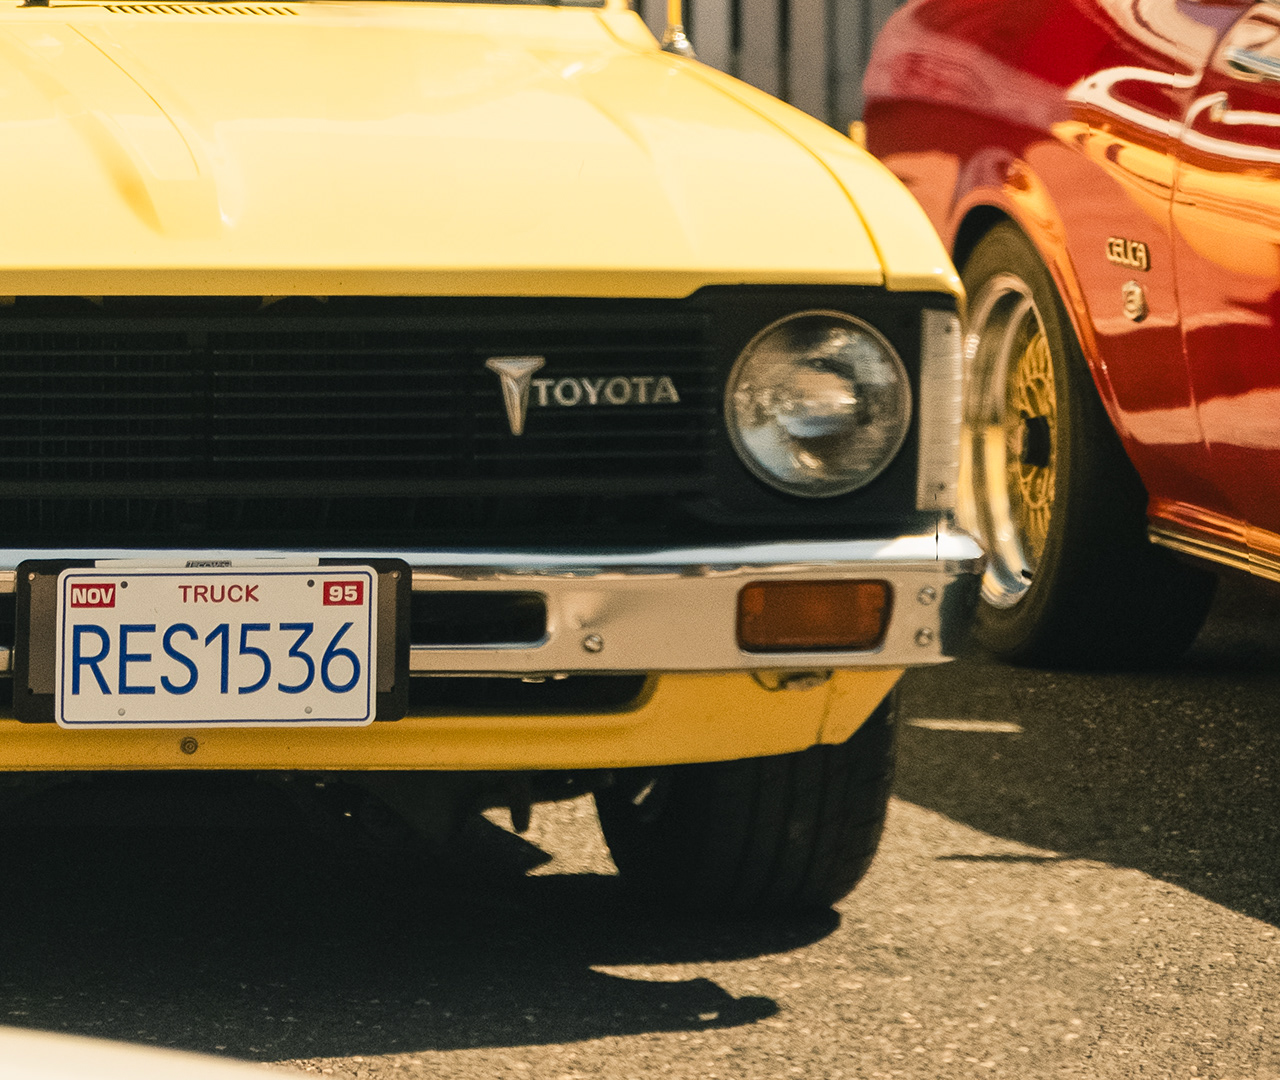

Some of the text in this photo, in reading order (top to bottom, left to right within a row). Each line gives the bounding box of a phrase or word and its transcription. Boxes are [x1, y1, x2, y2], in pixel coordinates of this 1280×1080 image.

[1105, 236, 1149, 271] CELICA
[531, 376, 680, 407] TOYOTA
[71, 587, 114, 605] NOV
[178, 584, 259, 603] TRUCK
[328, 585, 358, 602] 95
[71, 622, 361, 696] RES1536
